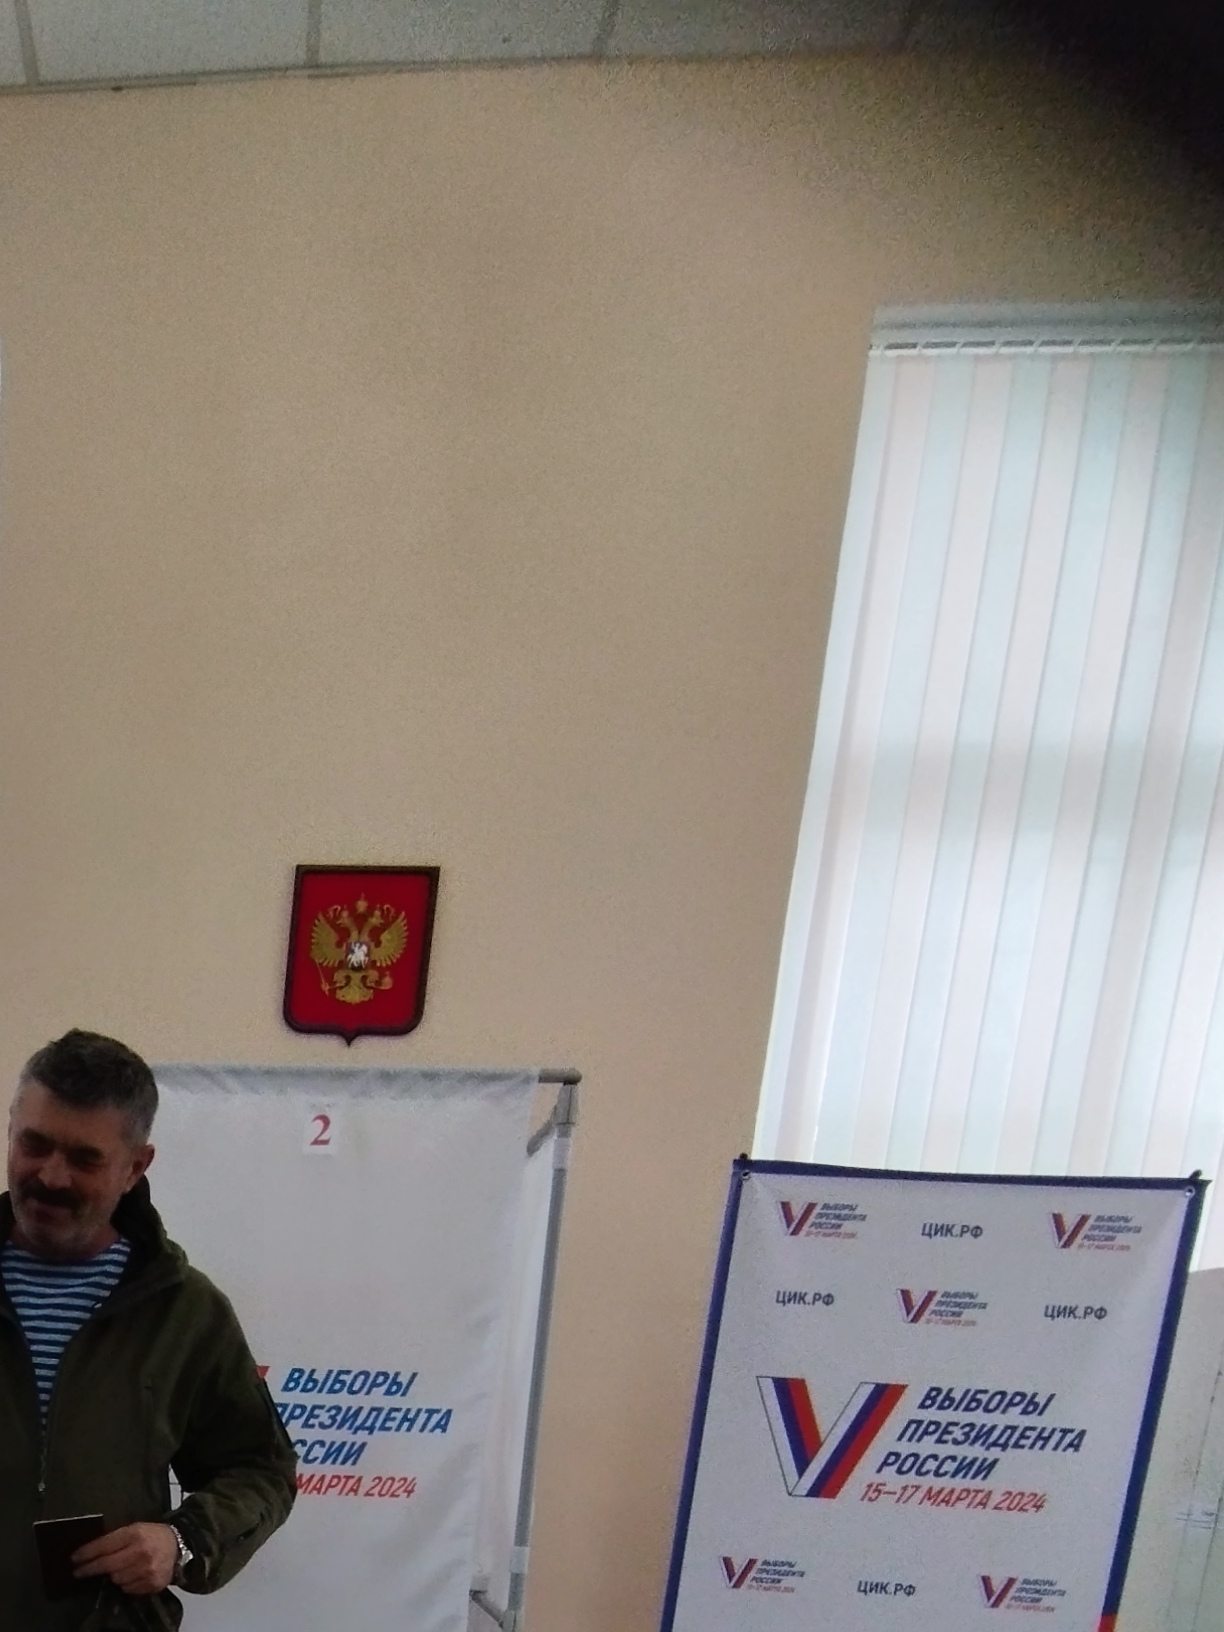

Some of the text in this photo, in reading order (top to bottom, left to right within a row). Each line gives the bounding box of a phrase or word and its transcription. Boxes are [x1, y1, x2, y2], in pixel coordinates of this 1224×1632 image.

[309, 1114, 332, 1146] 2
[920, 1222, 984, 1240] ЦИК.РФ
[775, 1290, 835, 1307] ЦИК.РФ
[1043, 1304, 1108, 1321] ЦИК.РФ
[281, 1367, 419, 1397] ВЫБОРЫ
[917, 1386, 1056, 1417] ВЫБОРЫ
[896, 1419, 1087, 1452] ПРЕЗИДЕНТА
[292, 1439, 368, 1466] ССИИ
[876, 1451, 1000, 1481] РОССИИ
[295, 1473, 418, 1498] МАРТА 2024
[919, 1486, 993, 1511] МАРТА
[992, 1491, 1047, 1514] 2024
[857, 1580, 916, 1597] ЦИК.РФ
